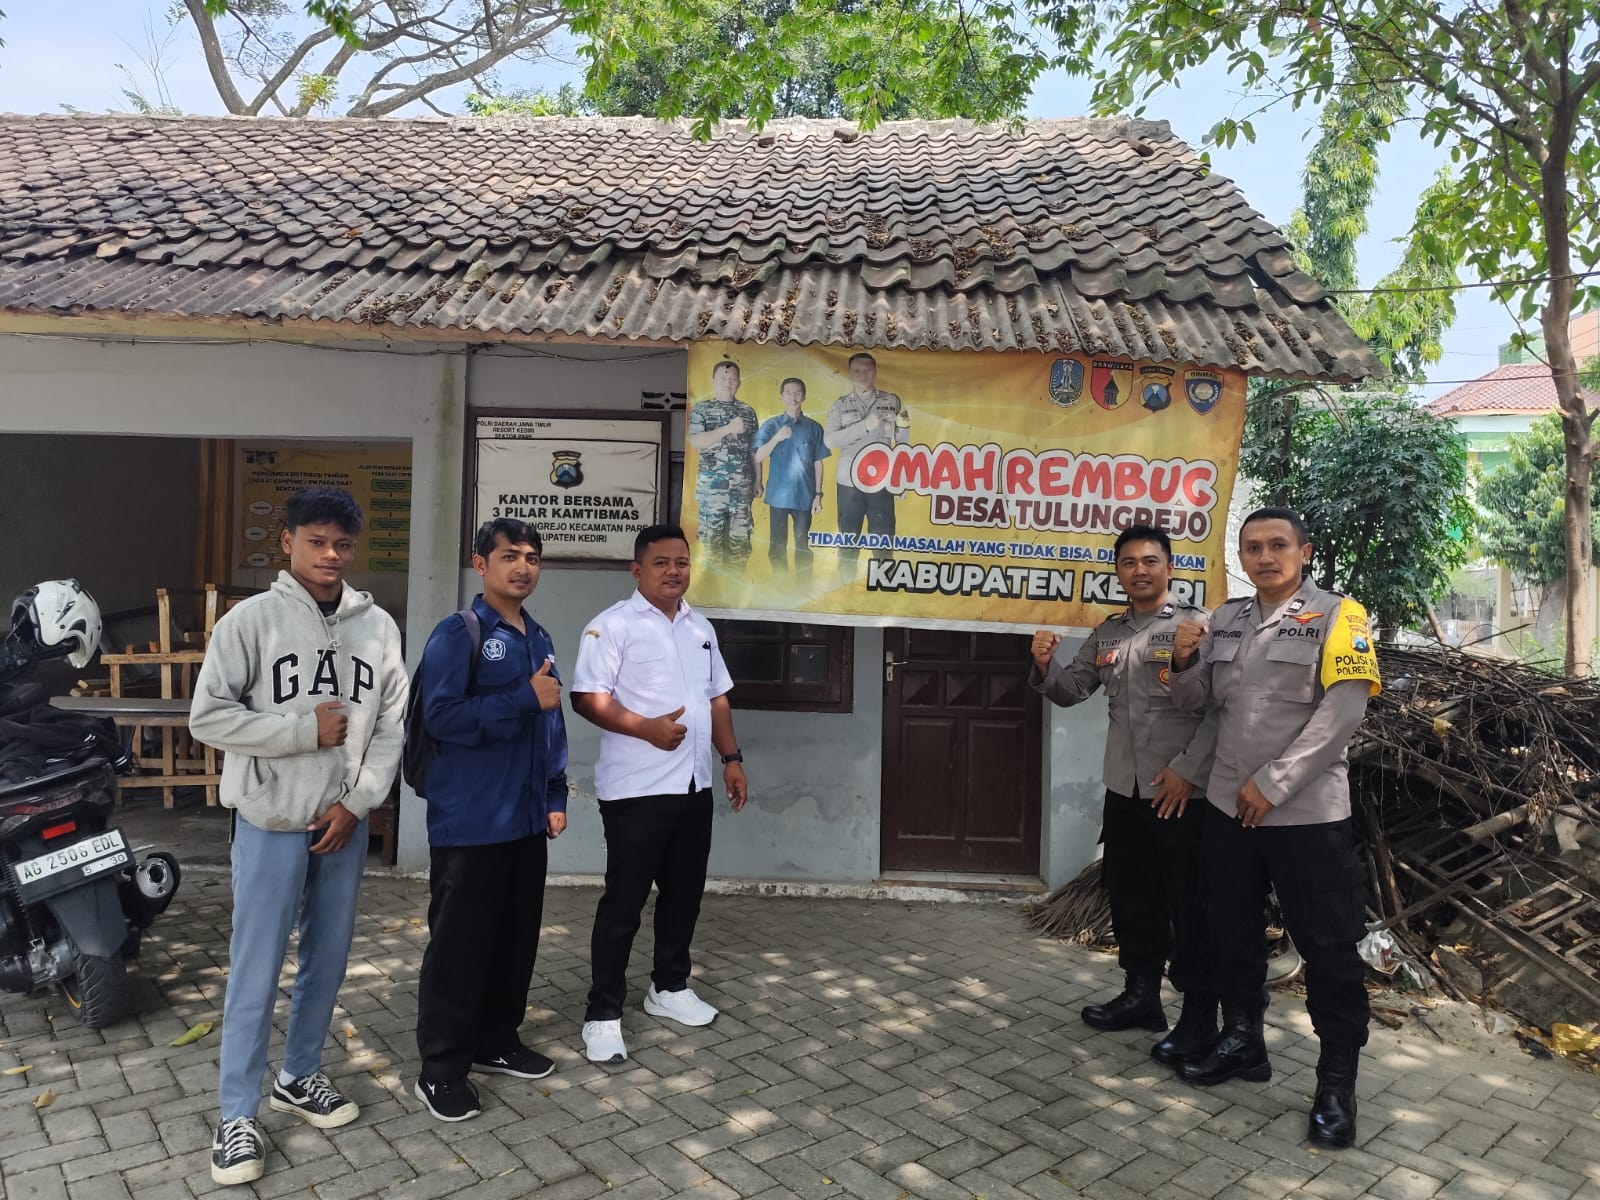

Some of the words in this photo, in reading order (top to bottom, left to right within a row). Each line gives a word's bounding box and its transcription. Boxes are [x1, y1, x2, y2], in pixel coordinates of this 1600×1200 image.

[1093, 361, 1133, 369] BRAWIJAYA
[855, 447, 997, 492] OMAH
[1005, 455, 1213, 507] REMBUG
[499, 494, 559, 506] KANTOR
[563, 495, 634, 508] BERSAMA
[492, 507, 500, 517] 3
[505, 507, 547, 518] PILAR
[552, 508, 640, 520] KAMTIBMAS
[933, 496, 1007, 524] DESA
[1015, 499, 1208, 537] TULUNGREJO
[570, 523, 623, 532] KECAMATAN
[578, 535, 607, 543] KEDIRI
[809, 532, 855, 546] TIDAK
[858, 534, 891, 548] ADA
[895, 536, 966, 552] MASALAH
[968, 540, 1006, 554] YANG
[1010, 543, 1056, 558] TIDAK
[1059, 546, 1093, 560] BISA
[867, 559, 1072, 601] KABUPATEN
[1083, 571, 1206, 607] KERI
[1151, 633, 1176, 642] POL
[1278, 627, 1320, 639] POLRI
[1335, 655, 1369, 667] POLISI
[271, 648, 375, 705] GAP
[1336, 666, 1367, 676] POLRES
[23, 861, 42, 879] AG
[91, 834, 120, 854] EDL
[111, 854, 126, 865] 30
